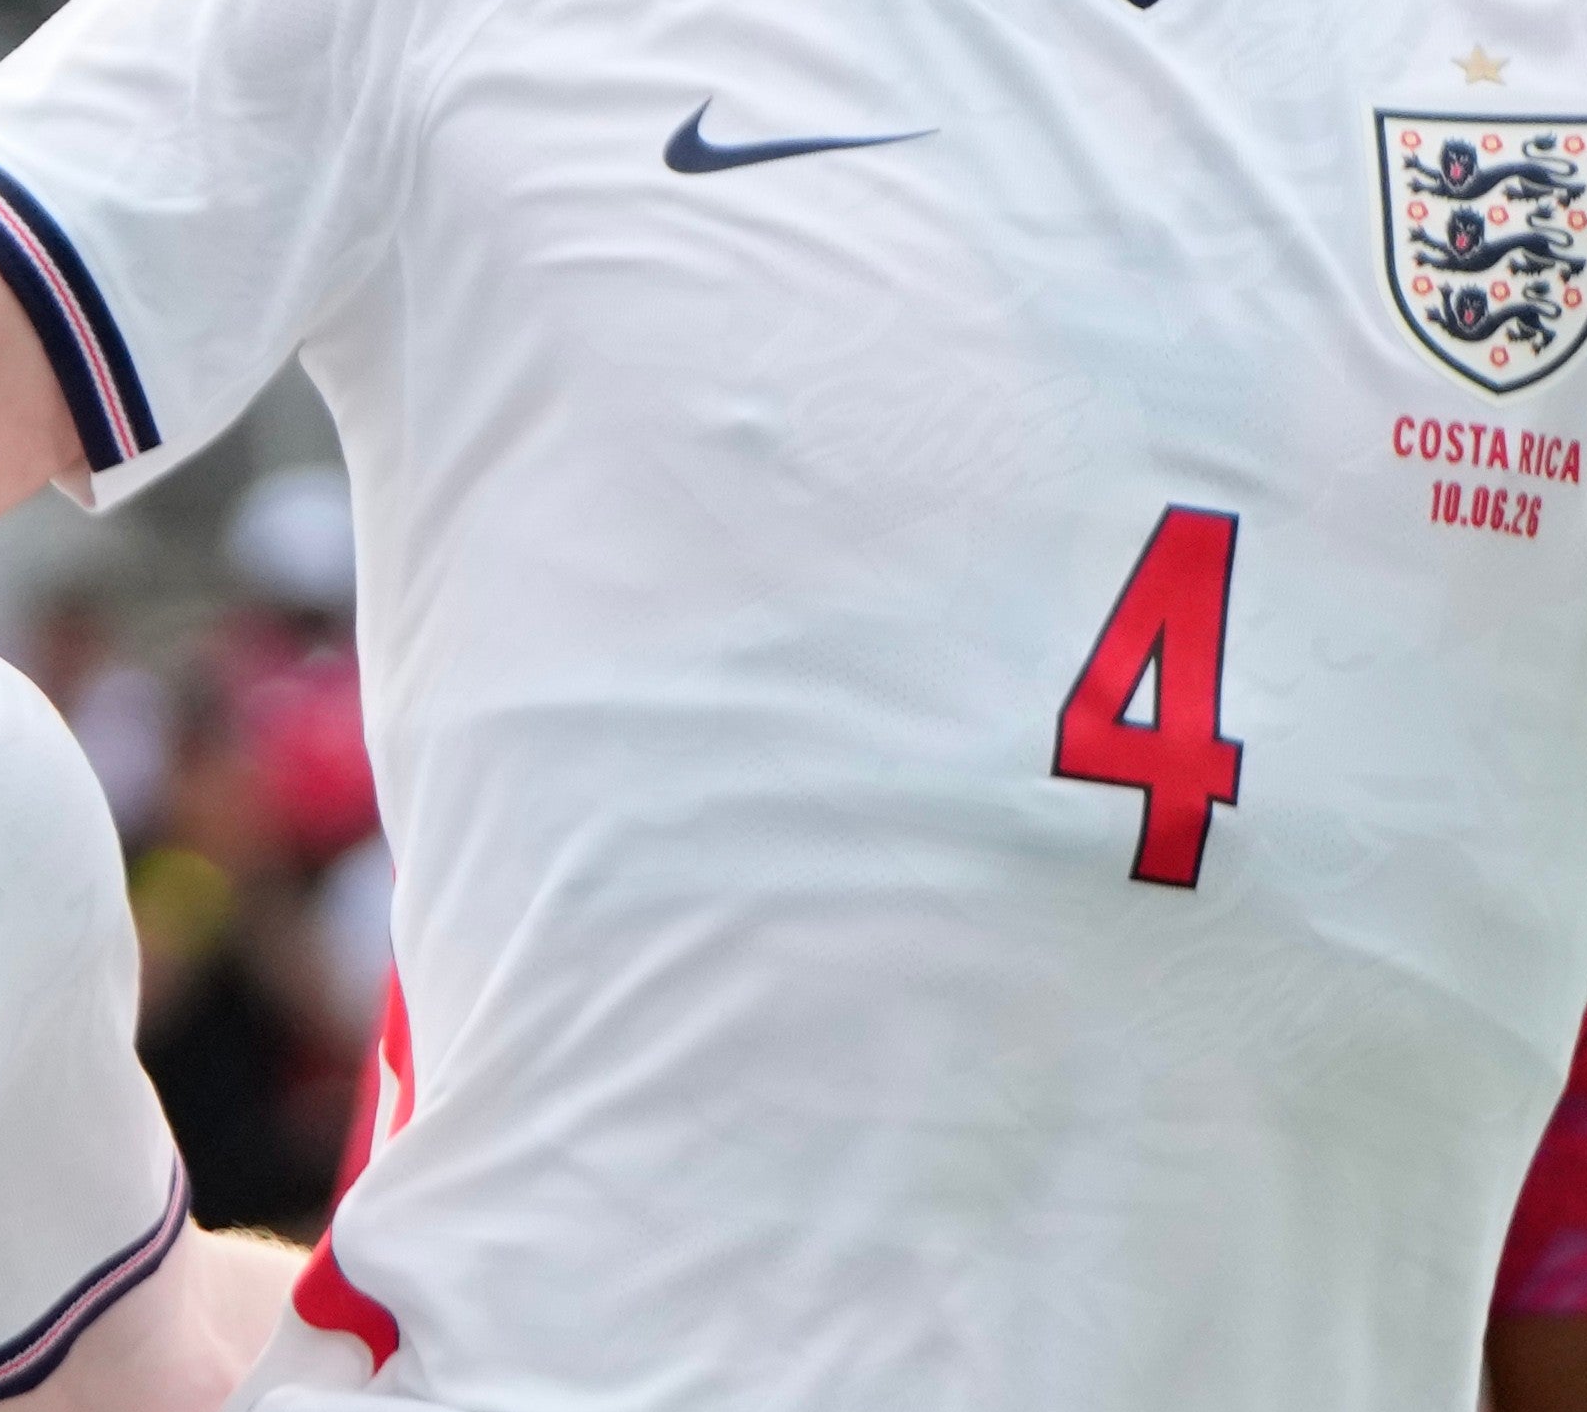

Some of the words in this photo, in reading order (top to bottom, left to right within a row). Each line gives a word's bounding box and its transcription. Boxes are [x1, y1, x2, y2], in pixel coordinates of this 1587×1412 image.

[1392, 414, 1509, 470] COSTA
[1518, 428, 1581, 484] RICA
[1430, 479, 1542, 537] 10.06.26
[1050, 501, 1244, 890] 4
